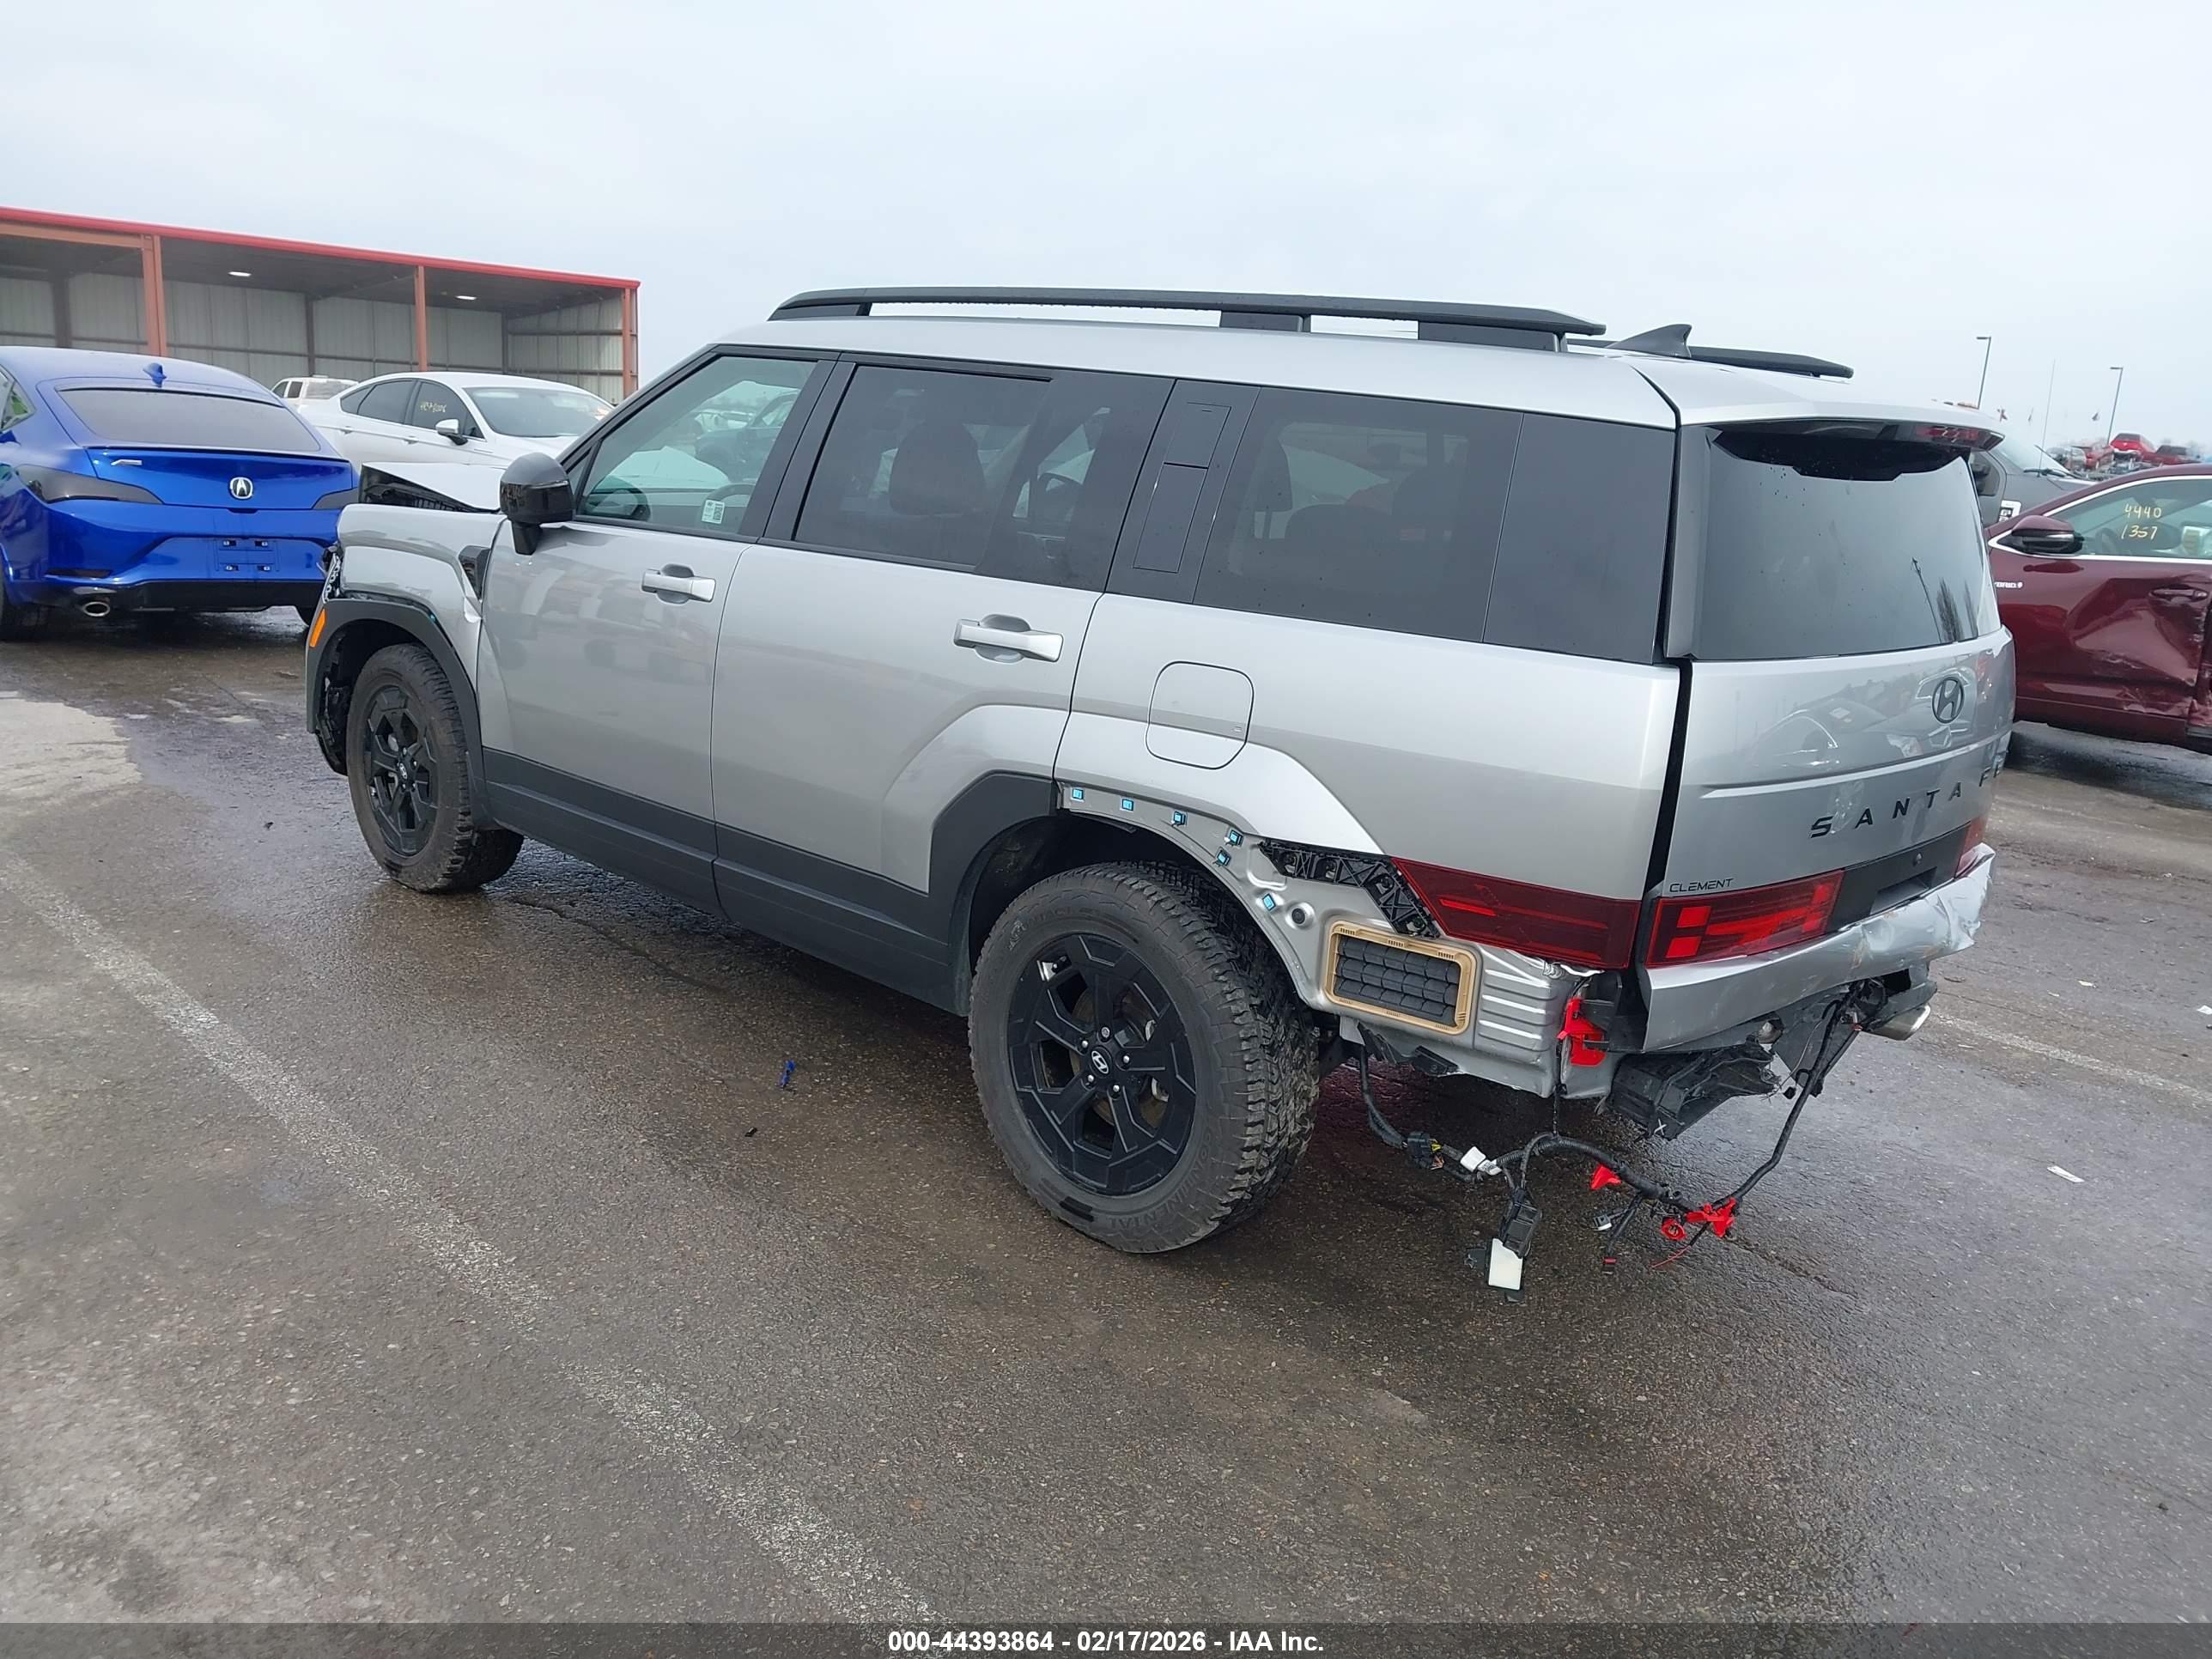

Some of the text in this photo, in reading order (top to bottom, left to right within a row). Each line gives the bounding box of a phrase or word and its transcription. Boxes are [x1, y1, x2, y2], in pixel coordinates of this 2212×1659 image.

[2124, 503, 2162, 520] 4440
[2121, 524, 2158, 540] 1357
[1809, 781, 1963, 839] SANTA
[1669, 878, 1735, 893] CLEMENT
